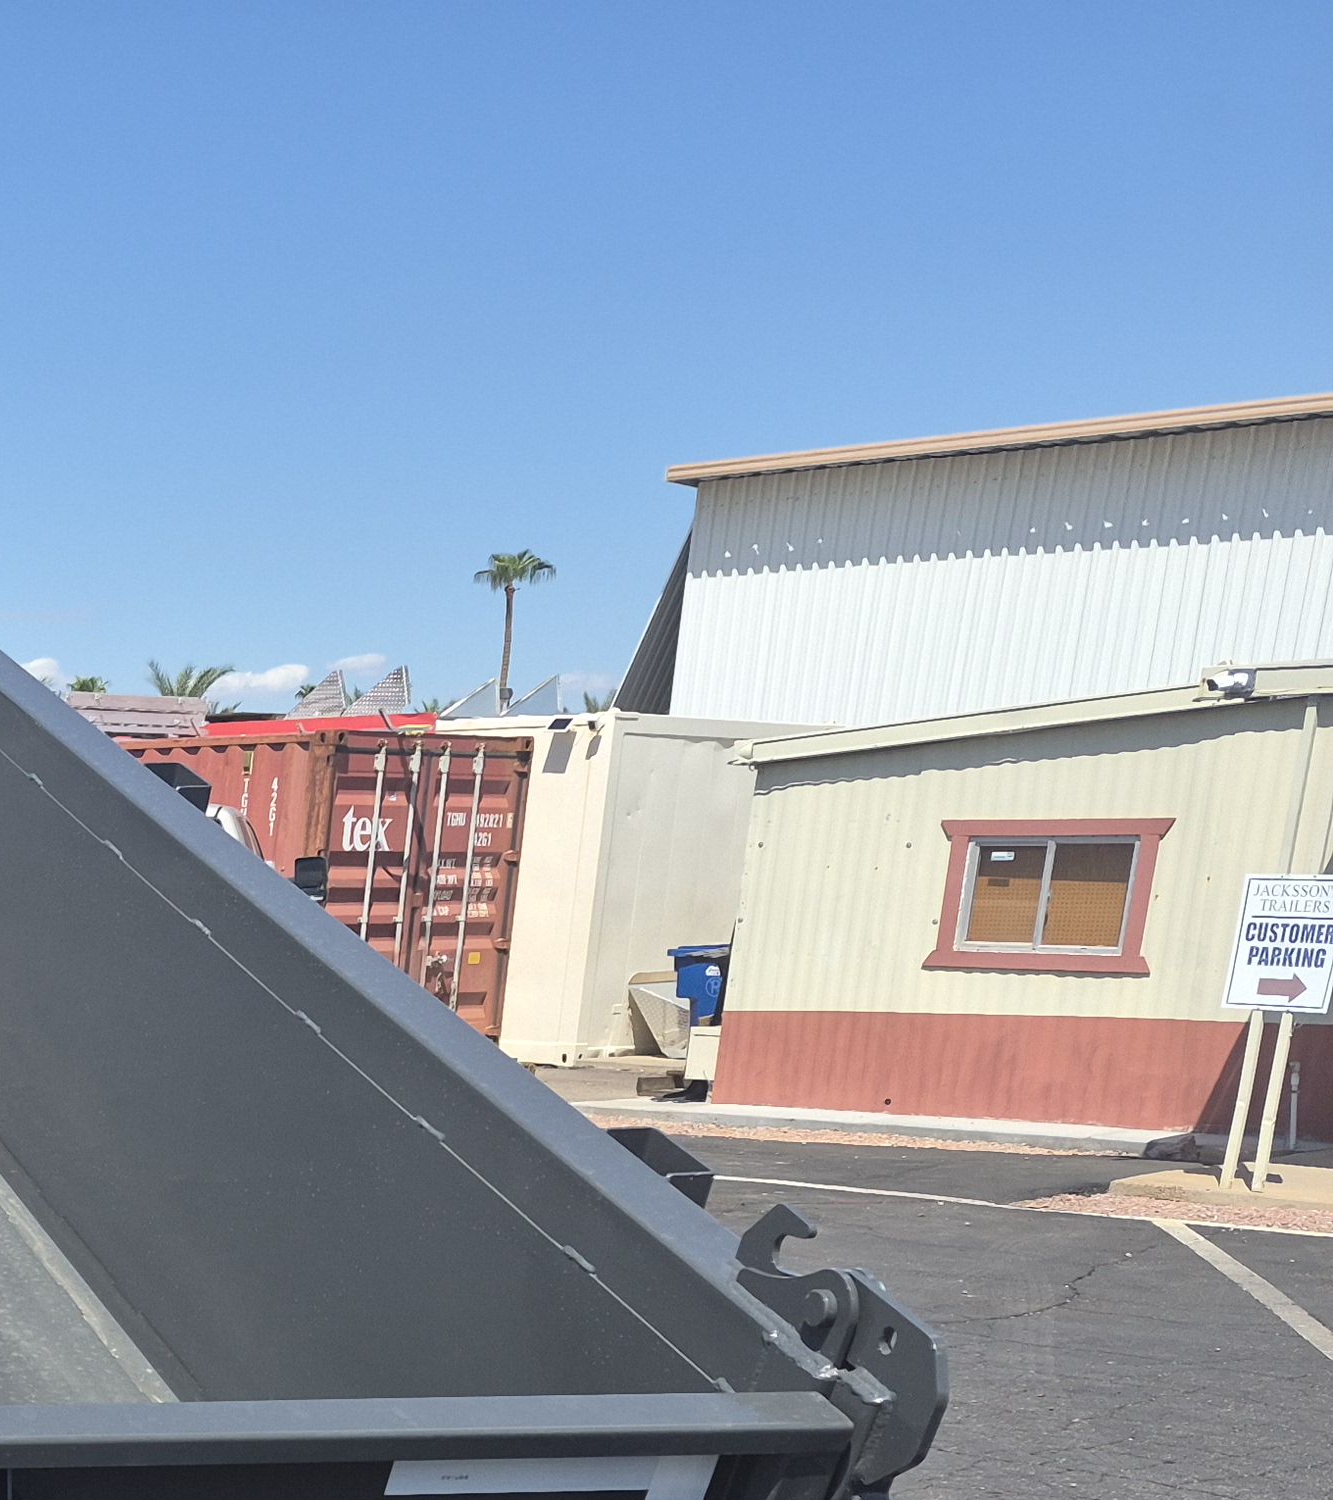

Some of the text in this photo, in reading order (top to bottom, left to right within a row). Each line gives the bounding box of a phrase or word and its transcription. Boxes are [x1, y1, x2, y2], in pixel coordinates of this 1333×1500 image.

[269, 777, 278, 837] 42G1
[1260, 898, 1331, 914] TRAILERS
[1245, 921, 1333, 945] CUSTOMER
[1247, 945, 1327, 968] PARKING
